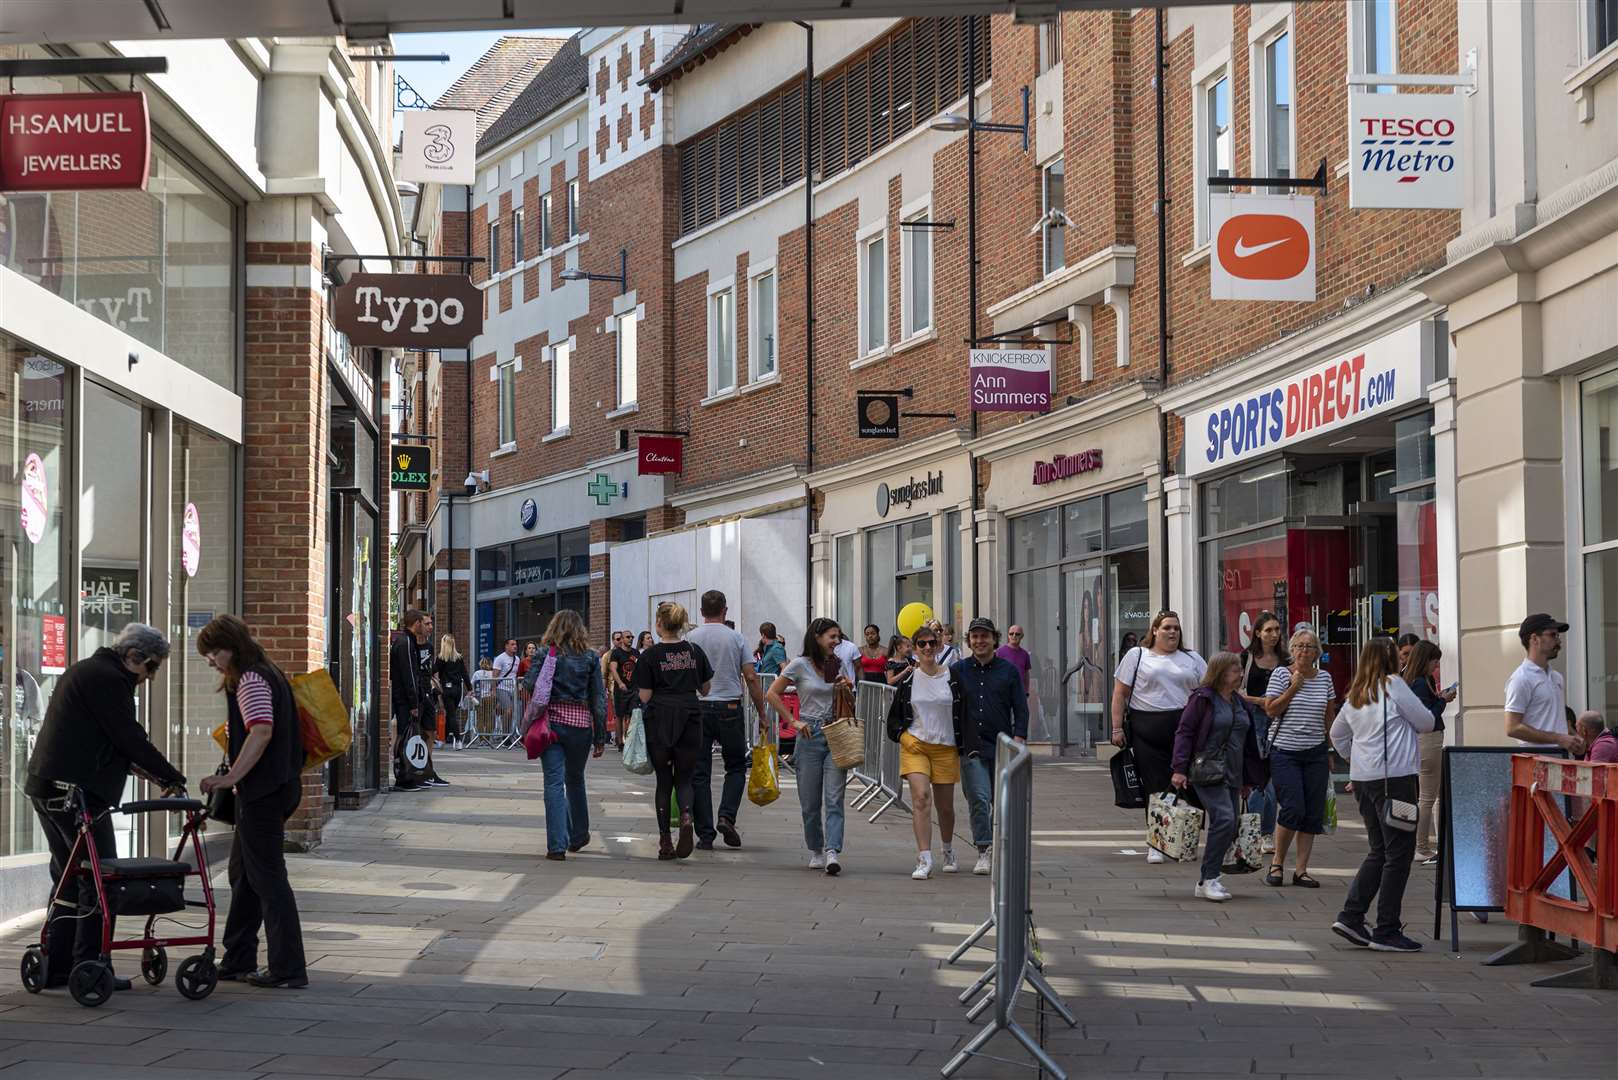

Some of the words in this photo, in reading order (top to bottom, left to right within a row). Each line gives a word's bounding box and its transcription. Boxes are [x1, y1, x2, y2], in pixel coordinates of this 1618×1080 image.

[9, 112, 132, 135] H.SAMUEL
[1360, 118, 1455, 137] TESCO
[424, 124, 455, 163] 3
[21, 153, 122, 177] JEWELLERS
[1362, 148, 1455, 173] Metro
[355, 286, 465, 333] Typo
[973, 352, 1047, 365] KNICKERBOX
[974, 373, 1007, 389] Ann
[974, 389, 1048, 405] Summers
[890, 475, 928, 509] sunglass
[927, 469, 944, 496] hut
[83, 580, 131, 598] HALF
[411, 743, 426, 760] JD
